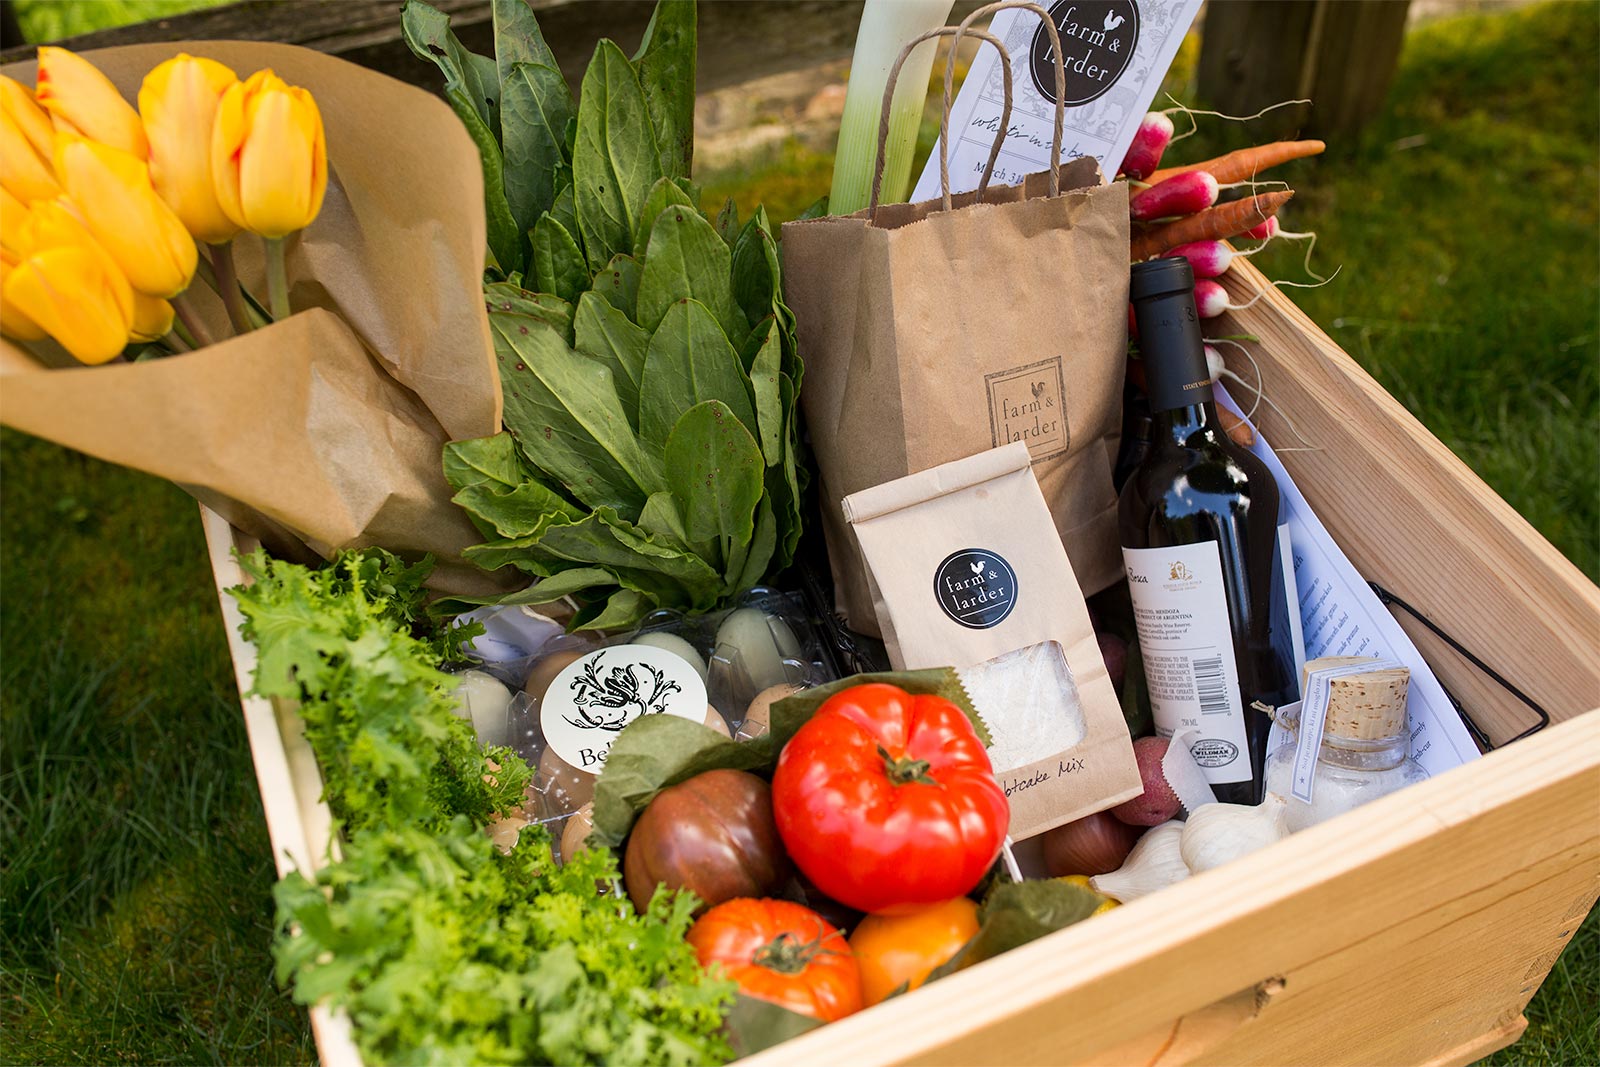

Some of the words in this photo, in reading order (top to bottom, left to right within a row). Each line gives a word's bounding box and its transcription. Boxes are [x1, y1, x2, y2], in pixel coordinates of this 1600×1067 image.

[1057, 6, 1106, 47] farm
[1108, 38, 1121, 53] &
[1043, 44, 1109, 82] lrder
[972, 115, 1029, 138] wht's
[1045, 141, 1067, 155] te
[973, 162, 1006, 181] Mch
[1003, 398, 1042, 420] farm
[1045, 397, 1055, 408] &
[1005, 416, 1058, 444] larder
[945, 574, 985, 593] farm
[988, 570, 998, 580] &
[952, 586, 1005, 611] larder
[1163, 612, 1192, 621] ARGENTINA
[1057, 758, 1085, 778] Mix
